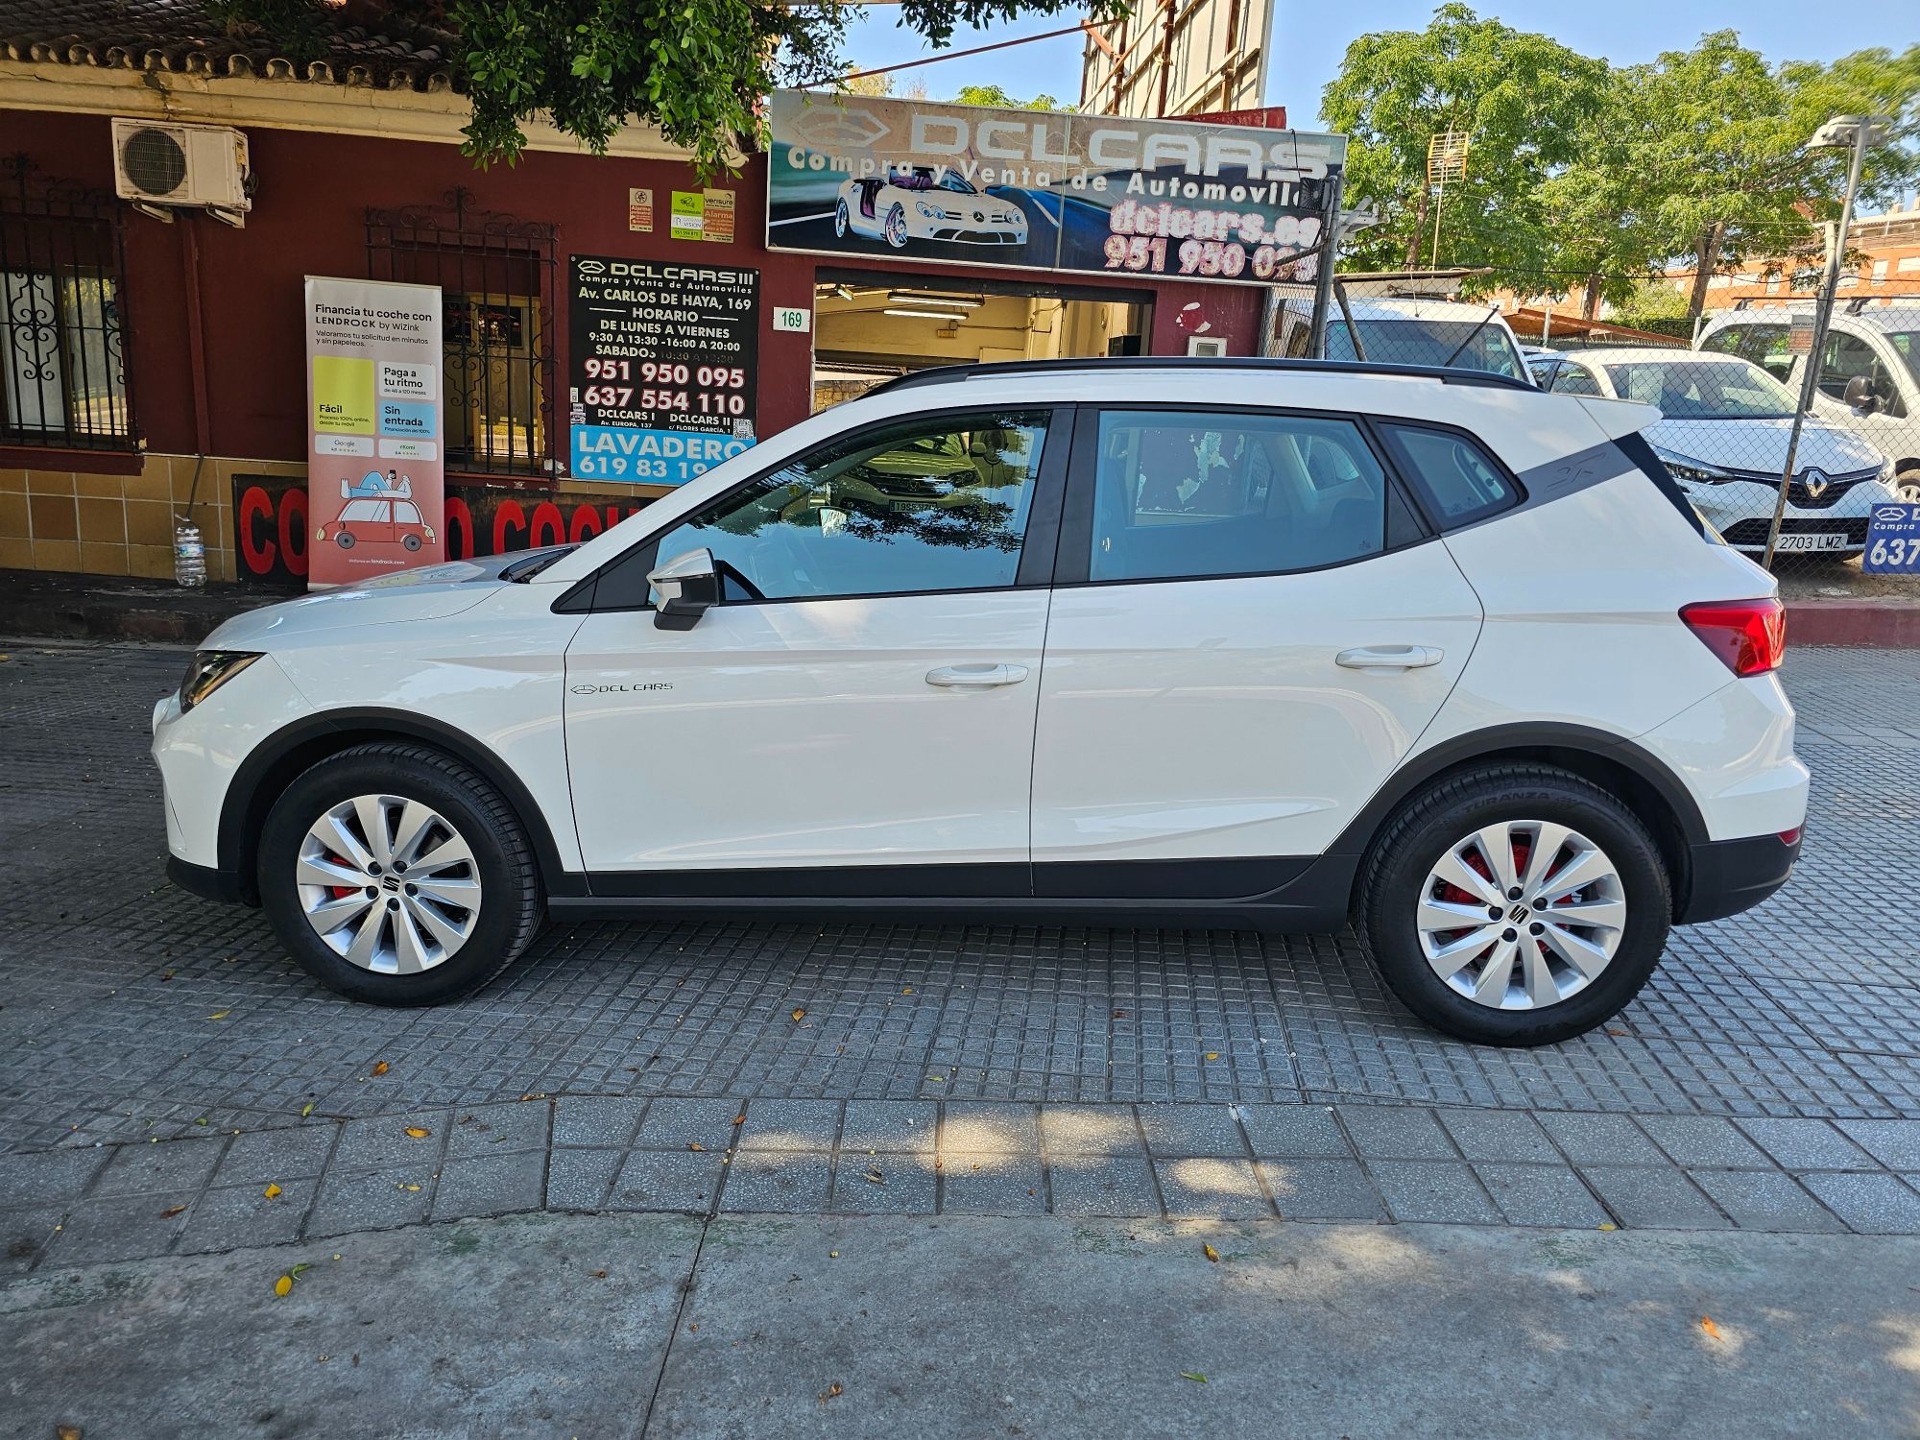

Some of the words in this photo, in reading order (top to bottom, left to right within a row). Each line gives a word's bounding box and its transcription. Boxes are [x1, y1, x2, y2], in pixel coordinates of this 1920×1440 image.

[911, 114, 1330, 182] DCLCARS
[787, 146, 914, 178] Compra
[933, 163, 948, 185] y
[960, 158, 1051, 187] Venta
[1071, 169, 1108, 192] de
[705, 210, 733, 219] Alarma
[1104, 234, 1168, 272] 951
[1179, 239, 1245, 278] 950
[579, 274, 619, 285] Compra
[625, 278, 630, 286] y
[633, 278, 664, 288] Venta
[669, 281, 682, 289] de
[687, 282, 752, 294] Automoviles
[578, 286, 600, 299] Av.
[603, 288, 656, 303] CARLOS
[660, 293, 678, 305] DE
[682, 295, 723, 310] HAYA,
[727, 298, 751, 310] 169
[315, 304, 360, 316] Financia
[363, 308, 374, 317] tu
[377, 310, 409, 320] coche
[412, 314, 432, 322] con
[632, 307, 699, 322] HORARIO
[782, 311, 802, 328] 169
[316, 316, 376, 328] LENDROCK
[379, 321, 390, 330] by
[392, 323, 420, 332] WiZink
[600, 320, 617, 330] DE
[621, 321, 661, 334] LUNES
[664, 324, 674, 335] A
[677, 325, 730, 339] VIERNES
[316, 330, 351, 339] Valoramos
[361, 333, 390, 342] solicitud
[401, 337, 429, 345] minutos
[333, 340, 366, 348] papeleos.
[588, 332, 613, 343] 9:30
[616, 334, 625, 343] A
[628, 335, 658, 346] 13:30
[699, 340, 707, 349] A
[710, 341, 740, 352] 20:00
[384, 367, 409, 379] Paga
[584, 358, 631, 380] 951
[641, 362, 689, 385] 950
[697, 367, 745, 388] 095
[384, 378, 395, 386] tu
[396, 378, 423, 388] ritmo
[584, 385, 634, 407] 637
[641, 388, 690, 412] 554
[700, 392, 745, 415] 110
[319, 404, 343, 414] Fácil
[384, 406, 401, 415] Sin
[598, 409, 648, 421] DCLCARS
[651, 412, 655, 421] I
[384, 416, 423, 427] entrada
[669, 413, 719, 425] DCLCARS
[723, 417, 730, 426] II
[579, 431, 748, 461] LAVADERO
[579, 456, 628, 474] 619
[636, 459, 667, 478] 83
[1873, 522, 1915, 531] Compra
[1780, 537, 1813, 549] 2703
[1817, 537, 1842, 549] LMZ
[1870, 539, 1920, 566] 637
[599, 684, 629, 693] DCL
[633, 682, 673, 691] CARS
